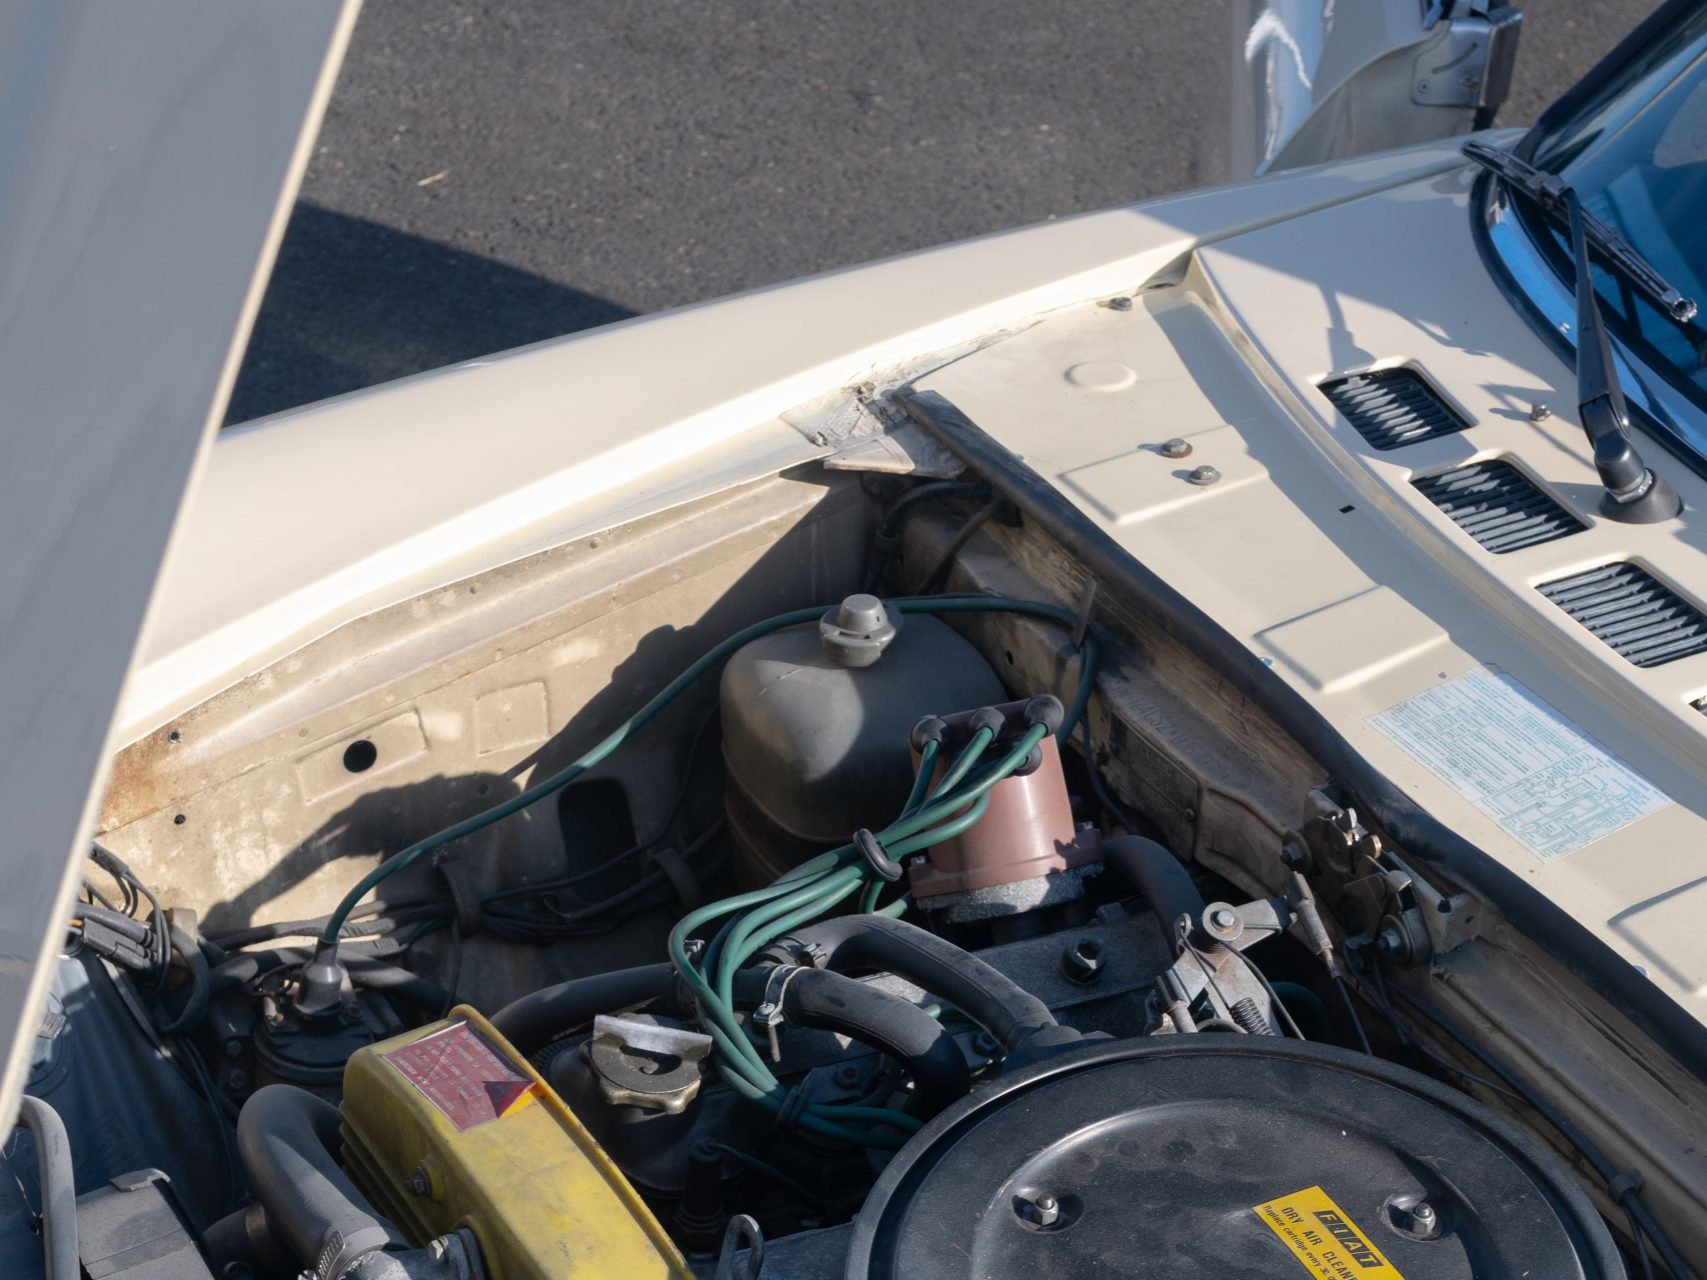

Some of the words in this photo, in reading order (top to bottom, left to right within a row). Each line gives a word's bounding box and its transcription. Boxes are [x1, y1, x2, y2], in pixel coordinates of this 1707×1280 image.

[1263, 1205, 1286, 1227] Replace
[1283, 1226, 1308, 1252] cartridge
[1306, 1252, 1322, 1267] every
[1281, 1207, 1304, 1224] DRY
[1303, 1230, 1323, 1246] AIR
[1315, 1211, 1382, 1267] FIAT
